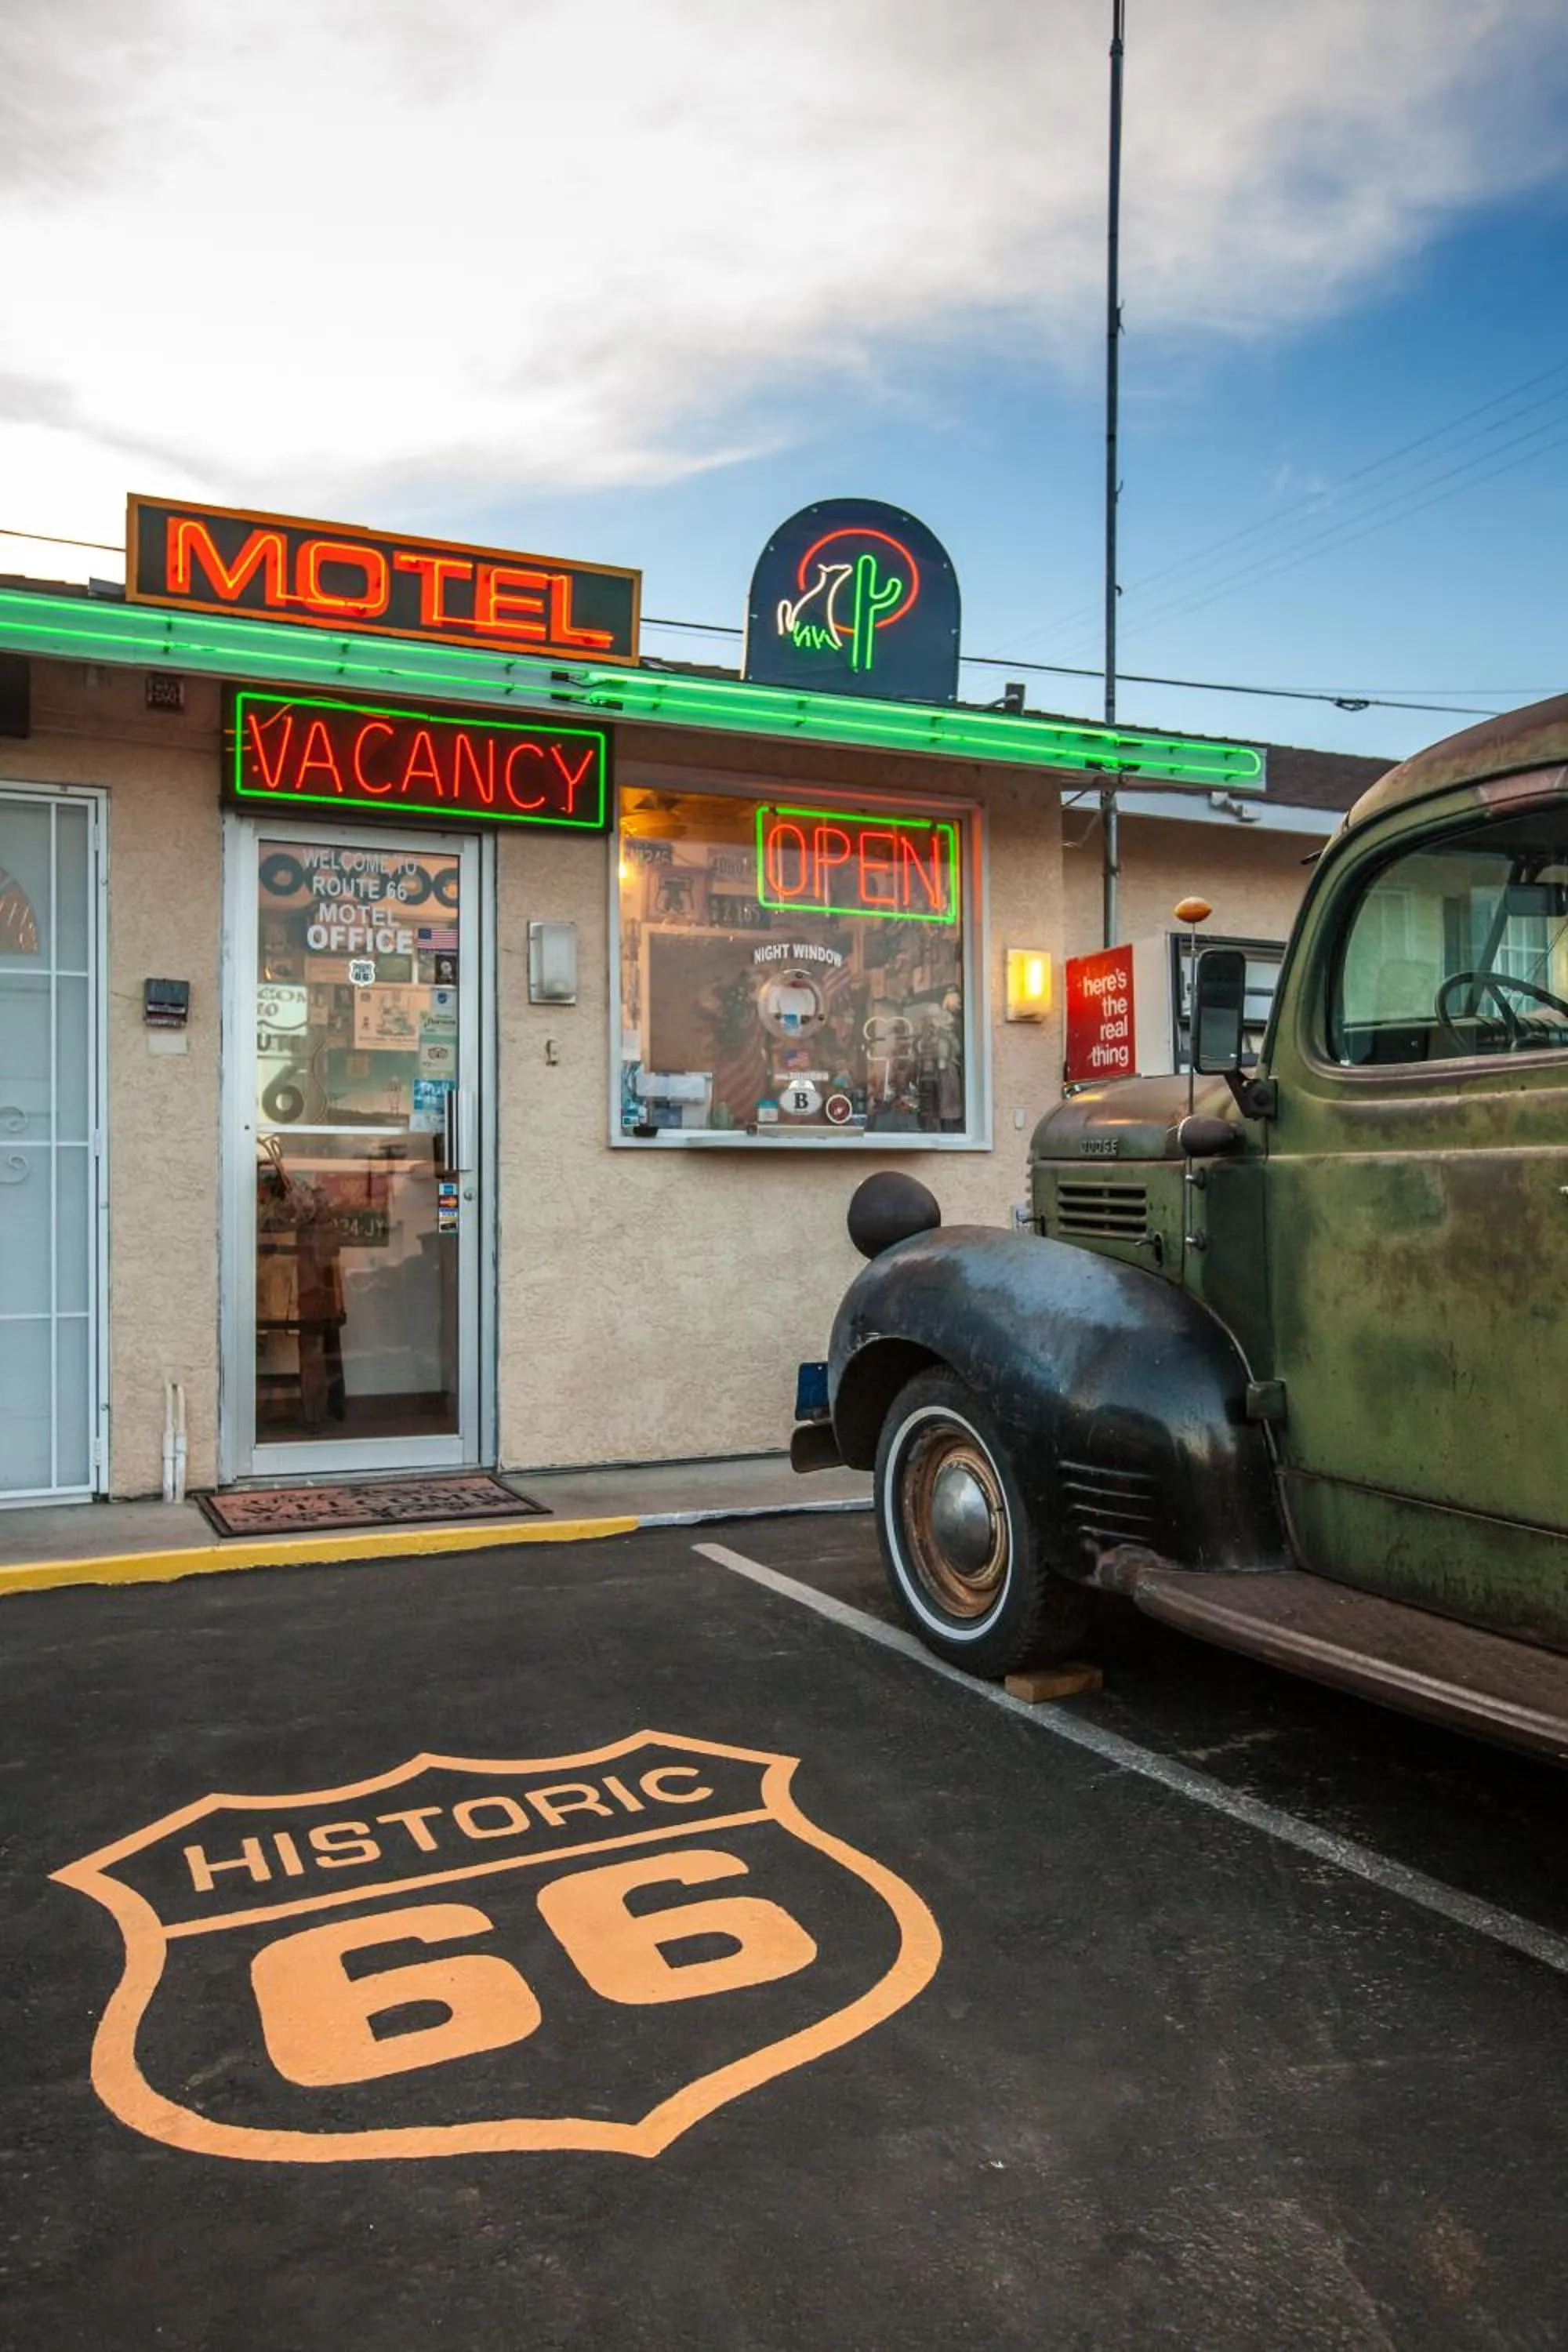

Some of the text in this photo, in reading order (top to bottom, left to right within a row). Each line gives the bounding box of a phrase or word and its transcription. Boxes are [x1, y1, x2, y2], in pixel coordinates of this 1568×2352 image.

[165, 517, 613, 648] MOTEL
[248, 713, 593, 813] VACANCY
[303, 848, 417, 876] WELCOME TO
[766, 823, 942, 909] OPEN
[313, 876, 407, 901] ROUTE 66
[319, 902, 400, 927] MOTEL
[307, 924, 413, 954] OFFICE
[754, 944, 843, 967] NIGHT WINDOW
[1082, 968, 1127, 996] here's
[1102, 996, 1128, 1018] the
[1100, 1020, 1128, 1040] real
[1091, 1043, 1129, 1068] thing
[793, 1092, 809, 1109] B
[1081, 1139, 1119, 1155] DODGE
[182, 1766, 714, 1892] HISTORIC
[250, 1849, 818, 2088] 66
